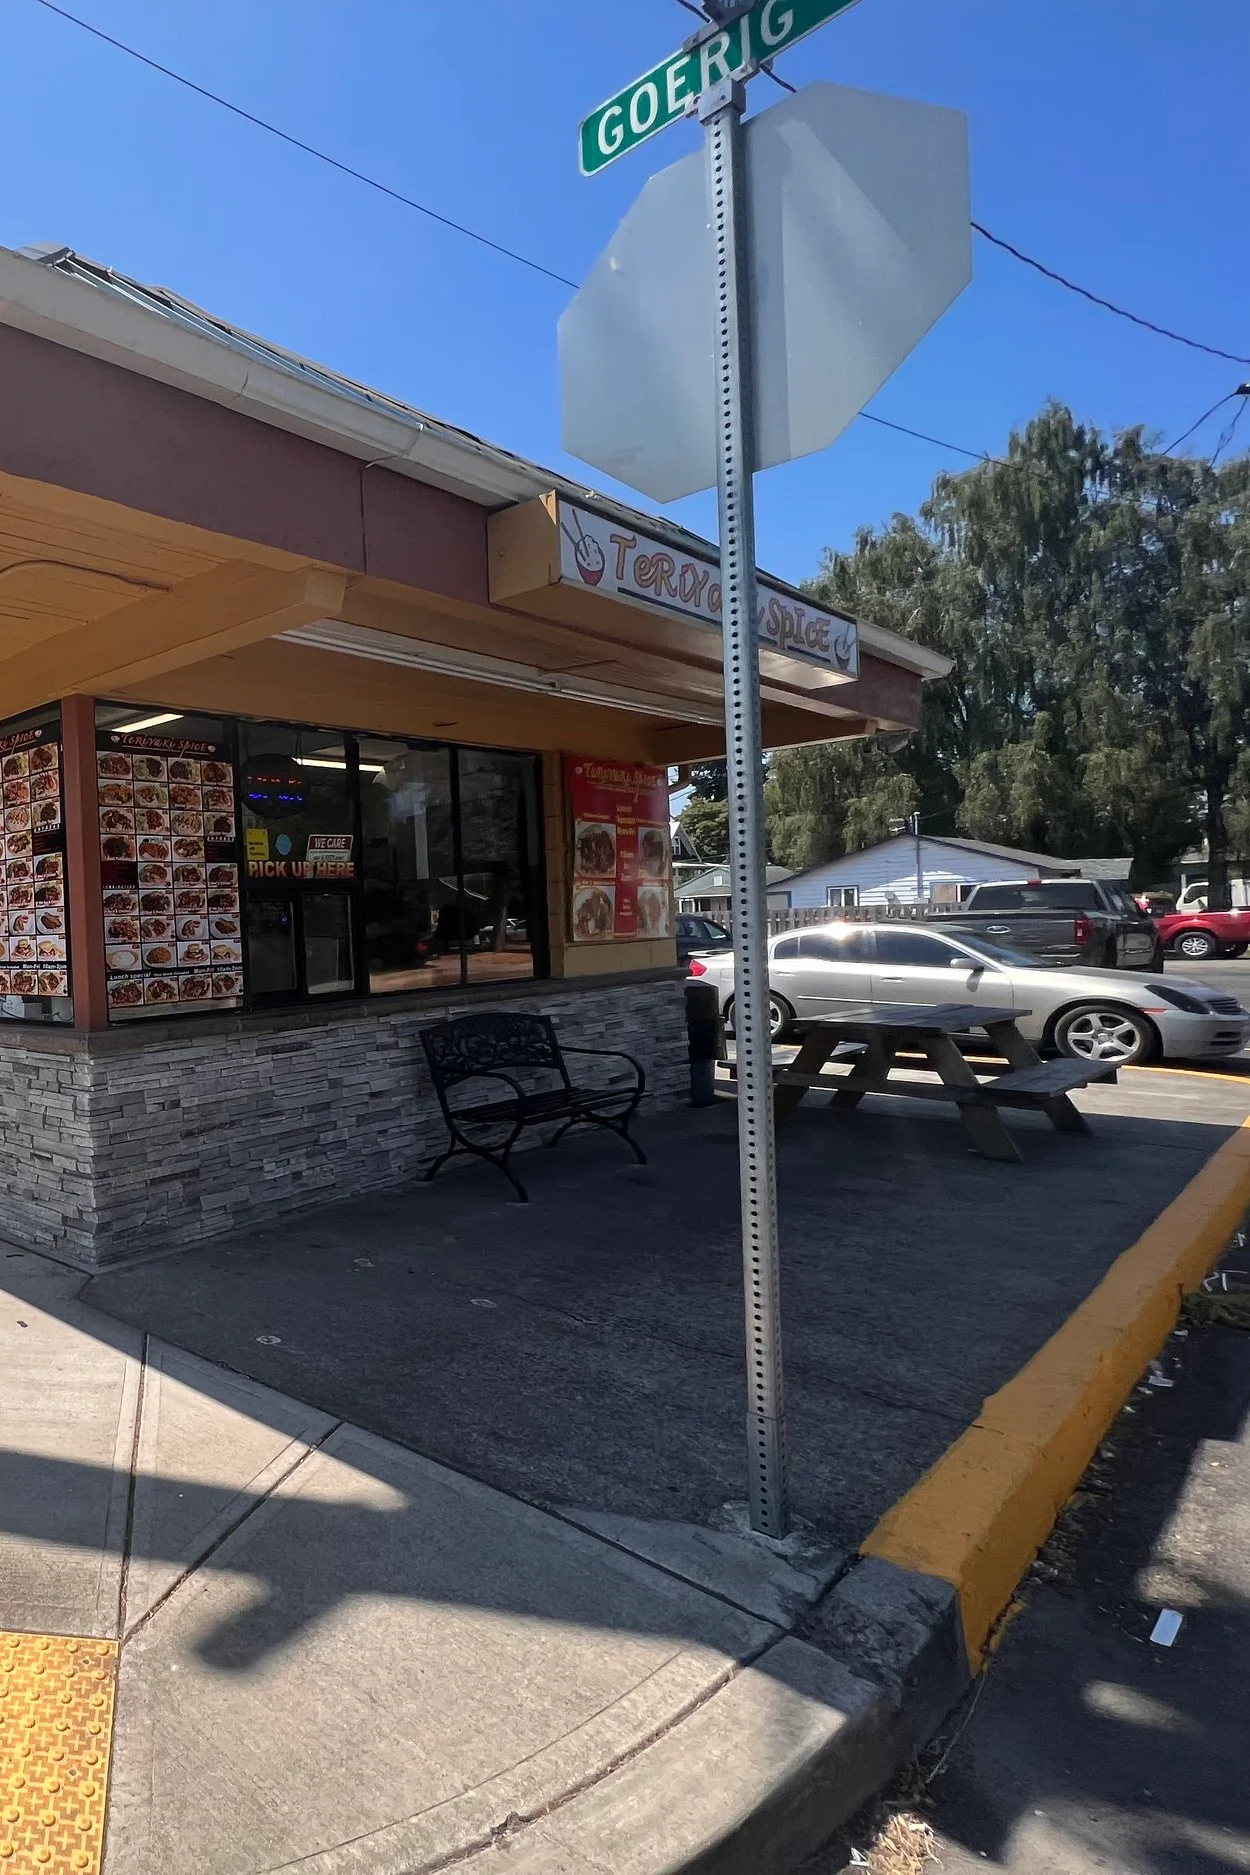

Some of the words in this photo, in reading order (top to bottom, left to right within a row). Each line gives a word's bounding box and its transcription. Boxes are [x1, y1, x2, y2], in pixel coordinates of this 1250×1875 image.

[597, 0, 795, 156] GOERIG
[314, 838, 327, 848] WE
[327, 838, 346, 849] CARE
[248, 861, 287, 878] PICK
[292, 861, 314, 878] UP
[316, 861, 355, 878] HERE
[130, 972, 151, 980] special
